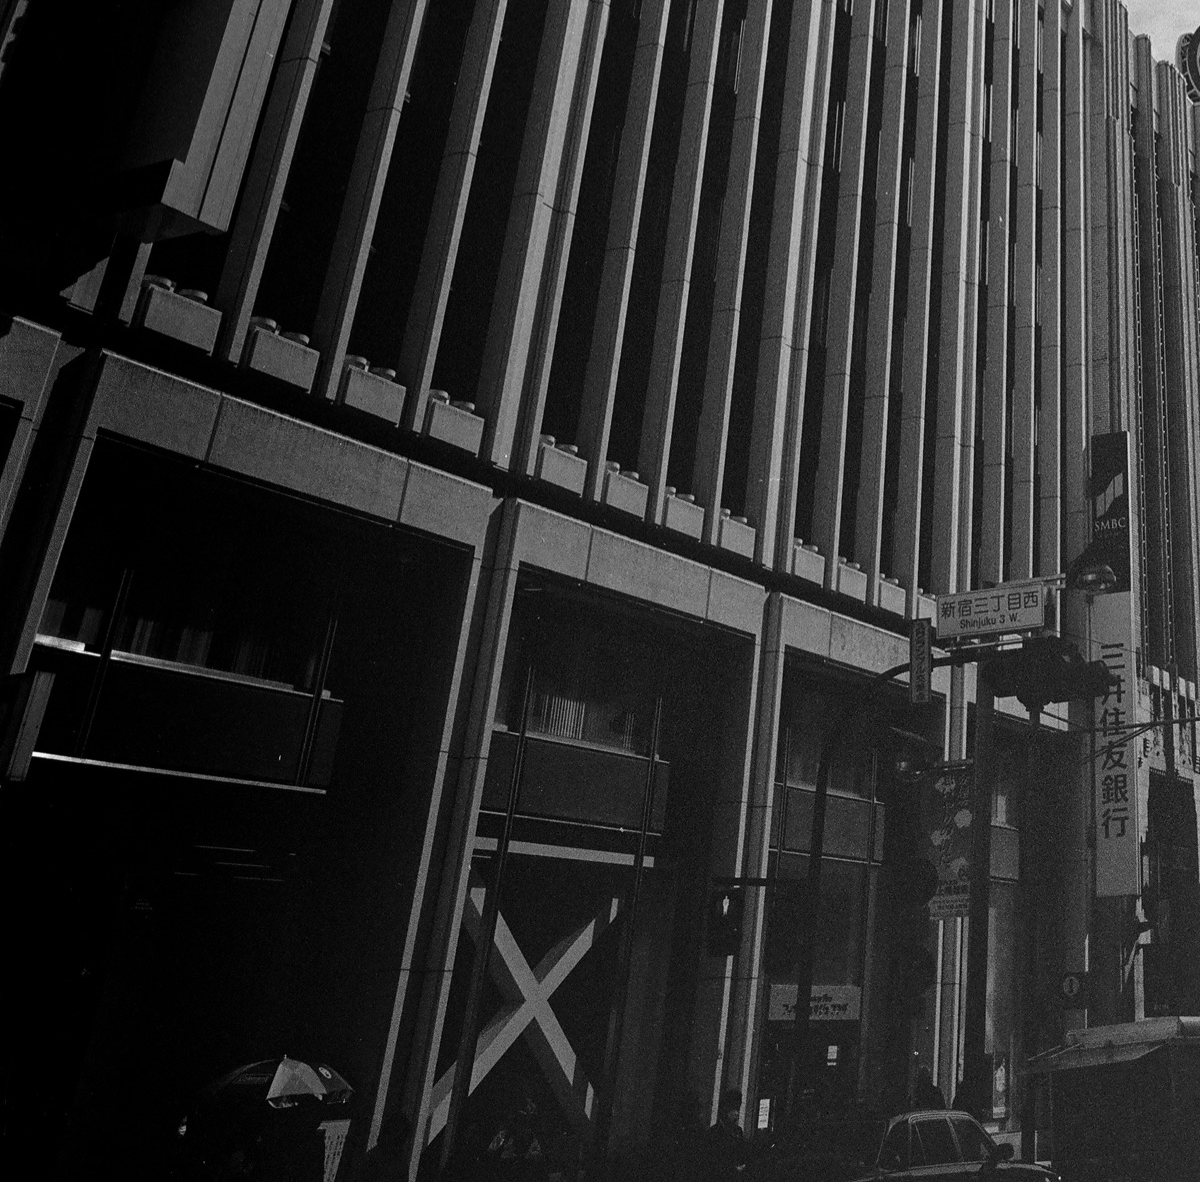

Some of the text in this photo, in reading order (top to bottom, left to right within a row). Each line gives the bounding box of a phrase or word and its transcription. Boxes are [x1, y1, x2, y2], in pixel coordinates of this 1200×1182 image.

[1095, 517, 1127, 531] SMBC
[941, 590, 1040, 619] 新宿三丁目西
[960, 616, 996, 629] Shinjuku
[999, 614, 1006, 624] 3
[1100, 643, 1129, 838] 三井住友銀行
